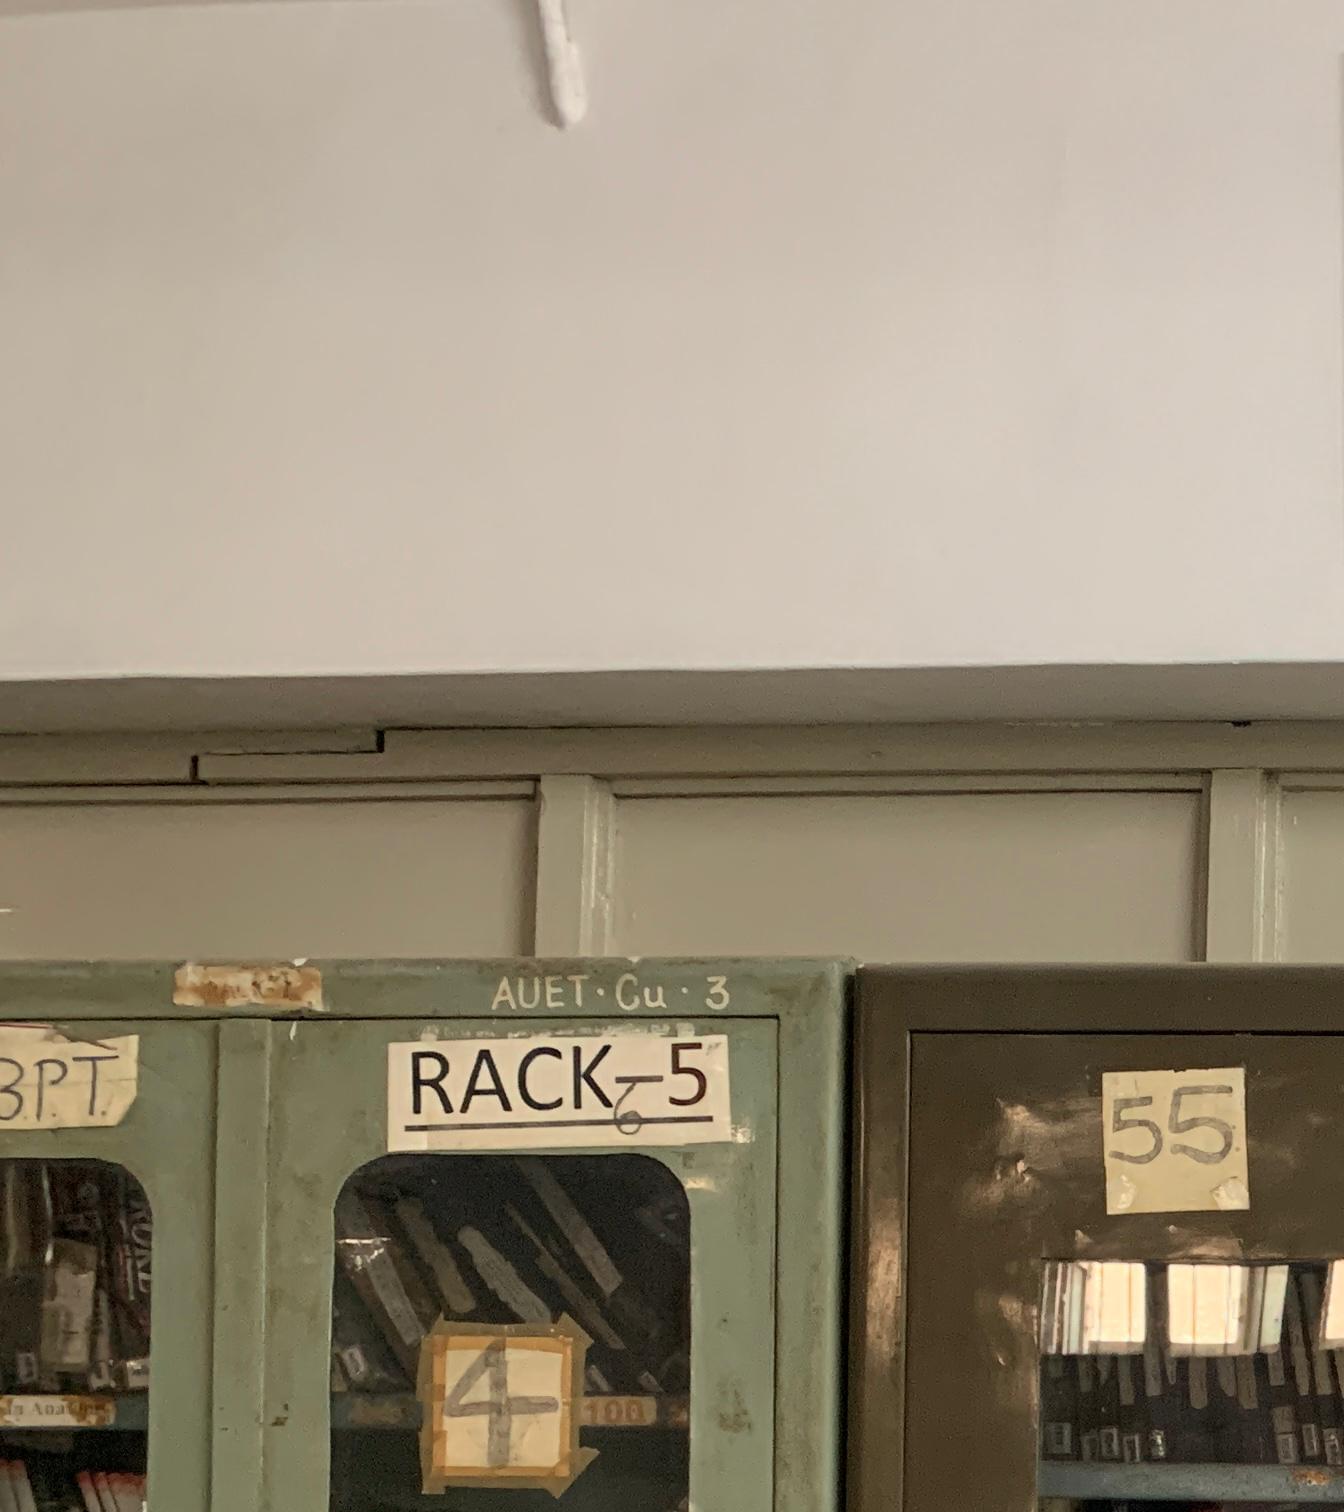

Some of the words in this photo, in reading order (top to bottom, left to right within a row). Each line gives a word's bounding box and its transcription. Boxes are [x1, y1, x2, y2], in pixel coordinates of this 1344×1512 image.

[411, 1042, 708, 1114] RACK-5
[1109, 1084, 1234, 1165] 55
[445, 1338, 560, 1469] 4
